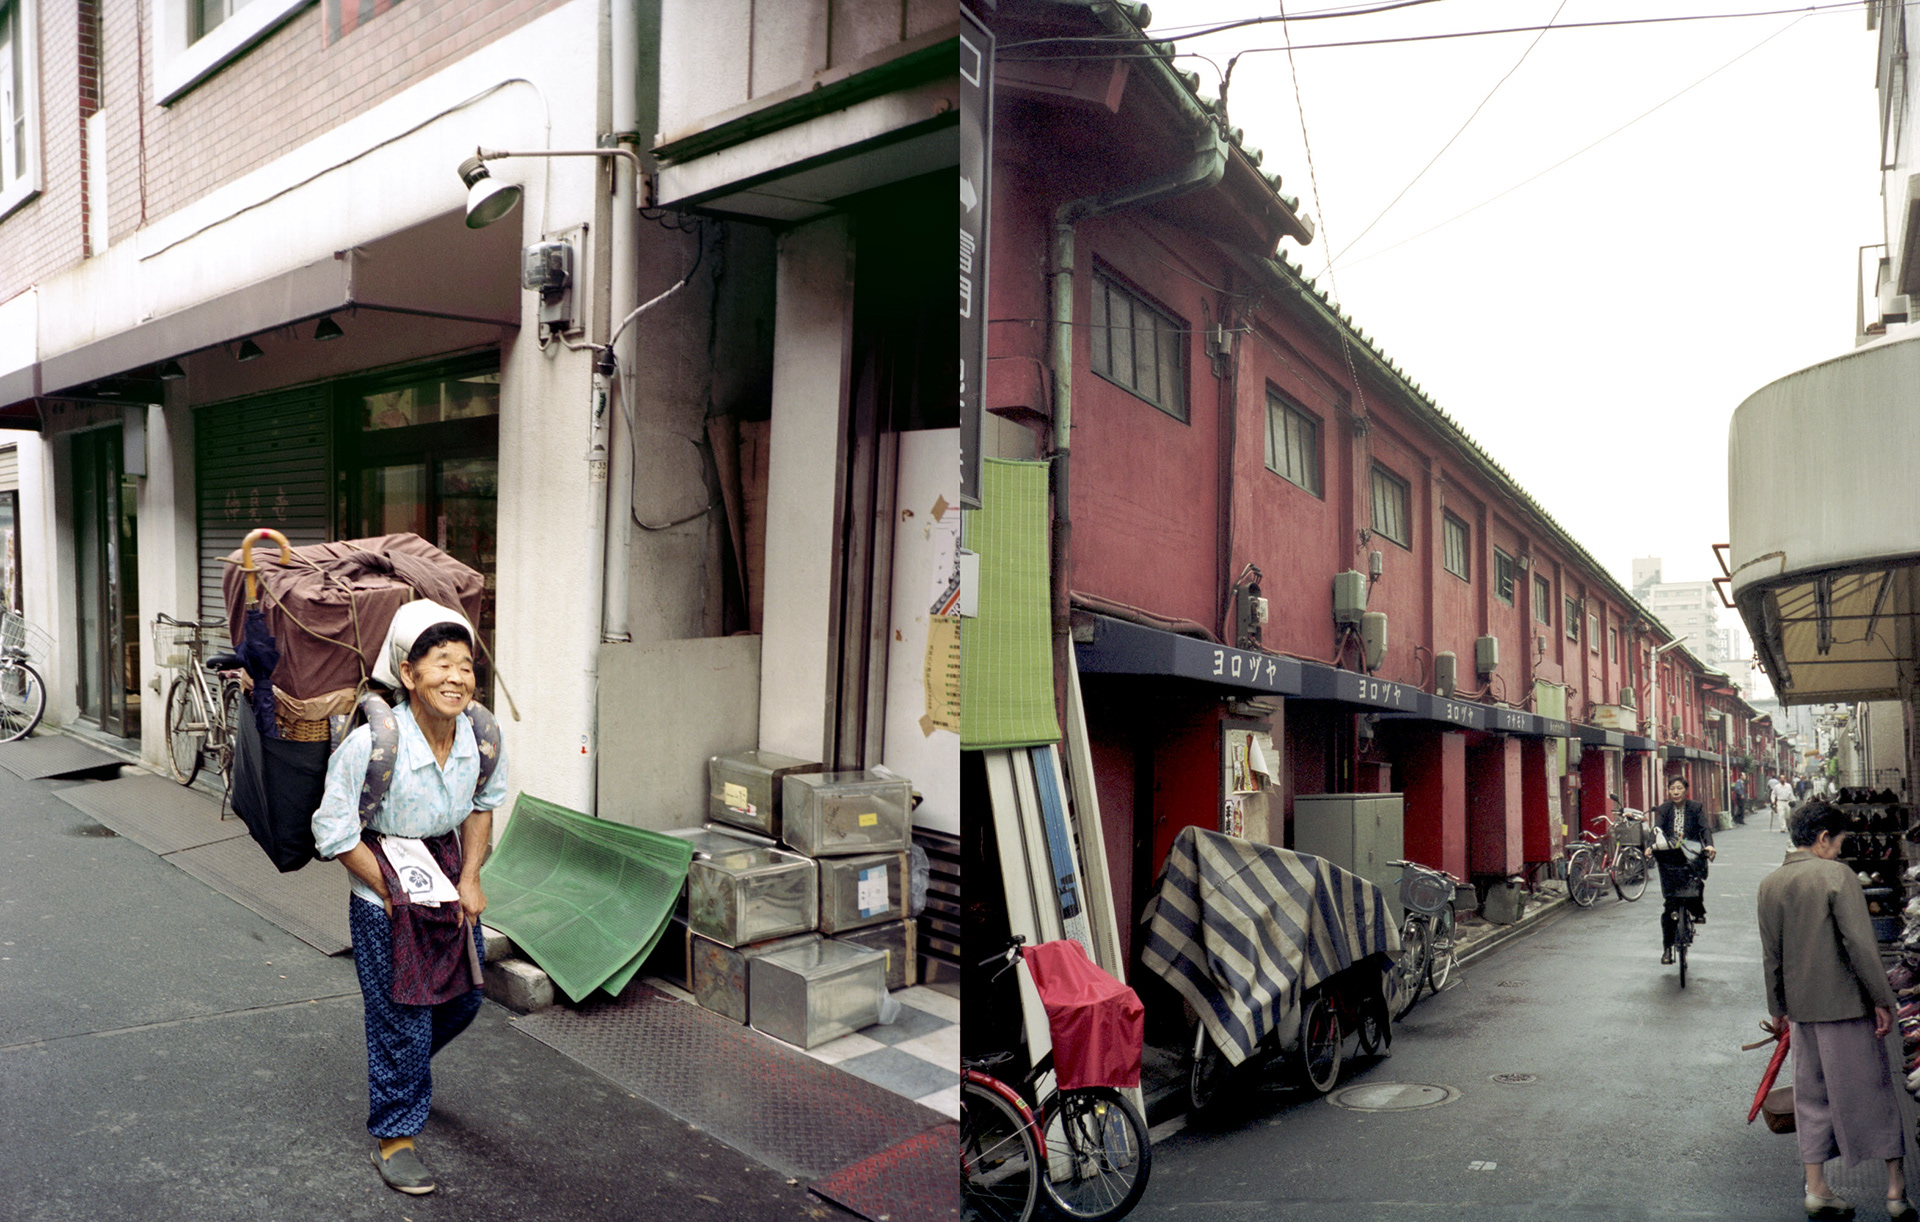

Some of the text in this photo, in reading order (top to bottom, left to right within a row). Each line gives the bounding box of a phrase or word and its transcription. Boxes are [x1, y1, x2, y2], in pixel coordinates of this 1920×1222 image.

[1213, 650, 1277, 686] ヨロヅヤ
[1358, 679, 1401, 706] ヨロヅヤ
